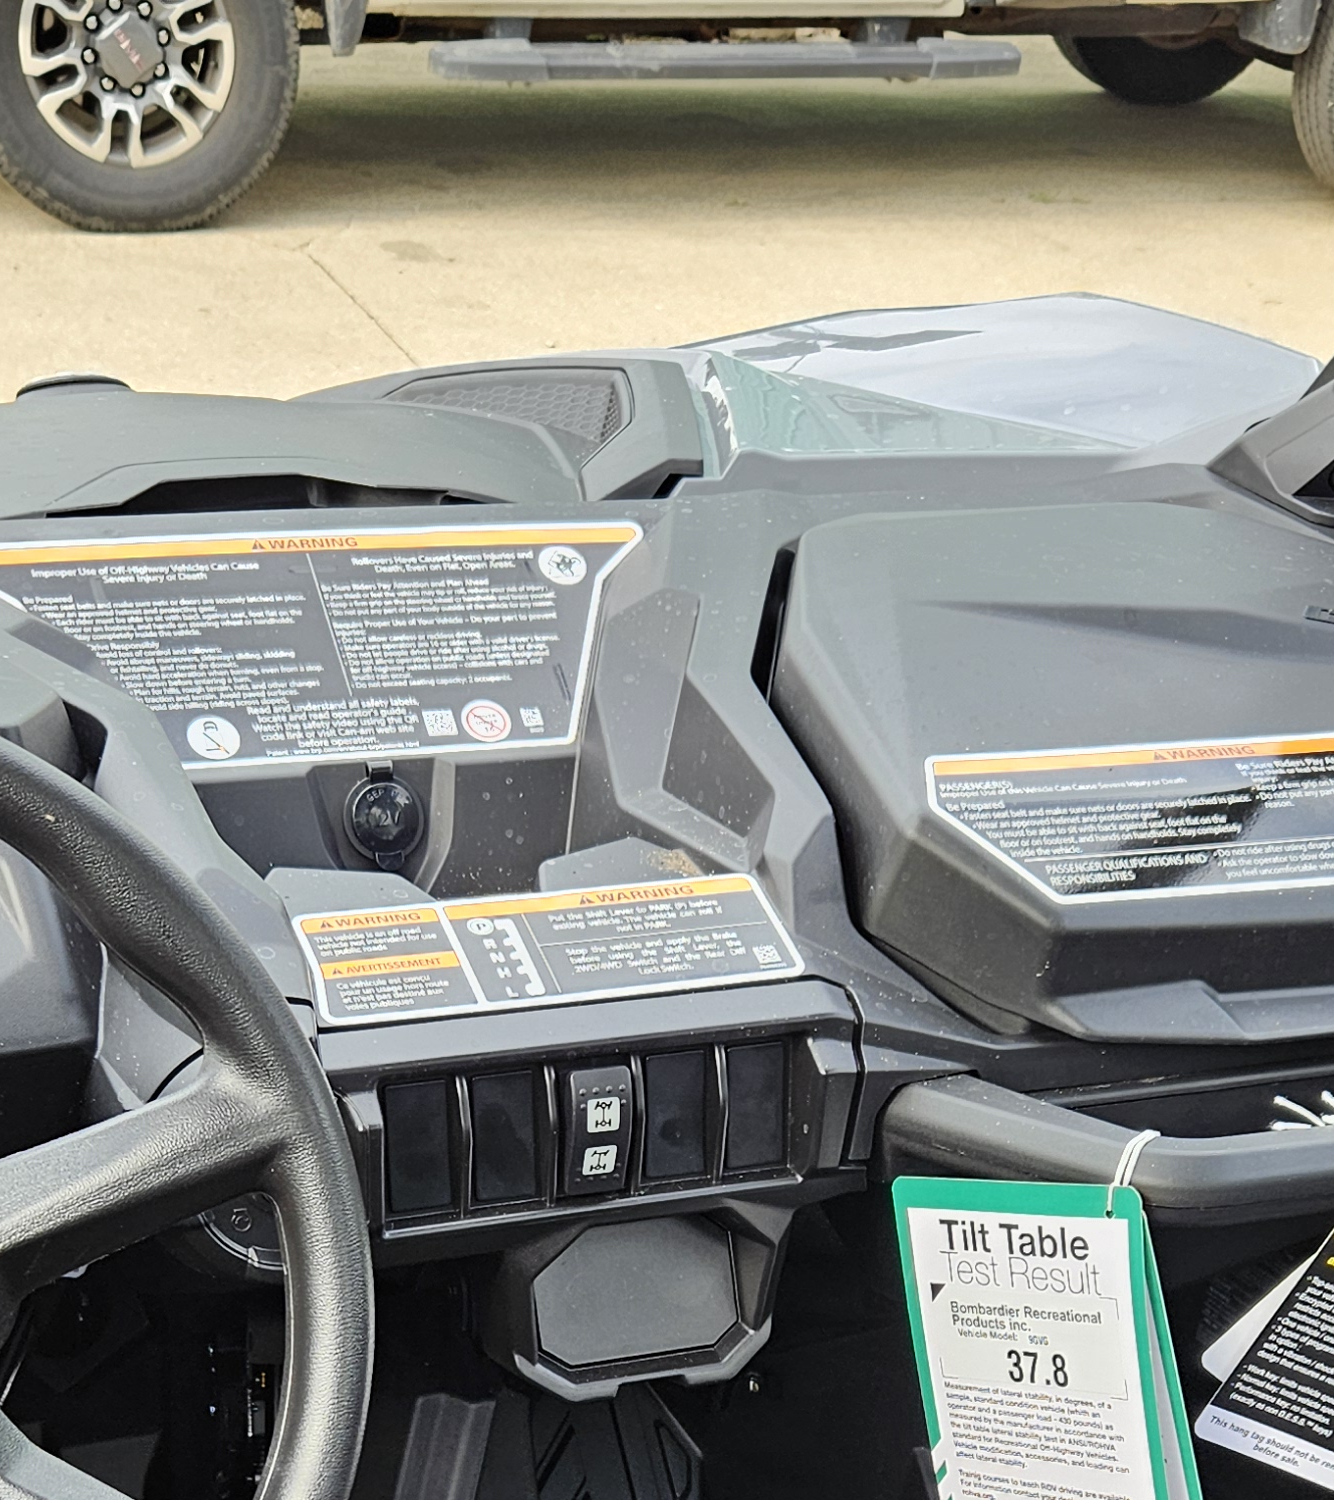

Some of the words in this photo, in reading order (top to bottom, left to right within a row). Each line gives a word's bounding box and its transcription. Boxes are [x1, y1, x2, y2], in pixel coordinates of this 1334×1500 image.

[268, 536, 357, 549] WARNING
[351, 556, 393, 565] Rollovers
[393, 555, 417, 564] Have
[418, 554, 451, 563] Caused
[452, 553, 482, 562] Severe
[483, 551, 515, 561] Injuries
[516, 551, 533, 559] and
[30, 567, 77, 578] Improper
[77, 567, 97, 576] Use
[96, 566, 109, 576] of
[108, 564, 171, 575] Off-Highway
[170, 562, 210, 573] Vehicles
[209, 562, 230, 571] Can
[229, 560, 259, 571] Cause
[102, 575, 136, 584] Severe
[135, 574, 165, 583] Injury
[165, 573, 177, 581] or
[177, 572, 208, 581] Death
[1166, 745, 1255, 759] WARNING
[939, 780, 1012, 792] PASSENGER(S)
[945, 803, 959, 812] Be
[960, 800, 1005, 811] Prepared
[1216, 848, 1230, 856] Do
[1230, 847, 1246, 855] not
[1246, 846, 1263, 854] ride
[1263, 844, 1282, 853] after
[1283, 842, 1306, 851] using
[1306, 840, 1330, 850] drugs
[1044, 861, 1104, 875] PASSENGER
[1101, 855, 1183, 871] QUALIFICATIONS
[1183, 853, 1208, 865] AND
[1221, 859, 1237, 867] Ask
[1237, 857, 1253, 865] the
[1253, 854, 1288, 864] operator
[1288, 853, 1298, 861] to
[1298, 852, 1317, 860] slow
[1048, 870, 1136, 886] RESPONSIBILITIES
[1225, 870, 1242, 879] you
[1242, 868, 1258, 877] feel
[1258, 864, 1318, 876] uncomfortable
[595, 884, 694, 903] WARNING
[334, 912, 421, 927] WARNING
[474, 922, 488, 931] P
[345, 957, 442, 973] AVERTISSEMENT
[489, 952, 505, 963] N
[495, 966, 512, 978] H
[505, 985, 519, 998] L
[938, 1218, 991, 1252] Tilt
[998, 1222, 1090, 1261] Table
[939, 1250, 1000, 1286] Test
[1008, 1256, 1102, 1296] Result
[950, 1300, 1020, 1317] Bombardier
[1023, 1305, 1101, 1324] Recreational
[952, 1313, 1005, 1329] Products
[1009, 1318, 1031, 1332] inc.
[957, 1327, 986, 1339] Vehicle
[990, 1330, 1018, 1342] Model:
[1006, 1348, 1068, 1387] 37.8
[1208, 1415, 1228, 1429] This
[1227, 1422, 1250, 1438] hang
[1249, 1431, 1265, 1443] tag
[1264, 1437, 1293, 1454] should
[1293, 1448, 1309, 1460] not
[1309, 1454, 1320, 1464] be
[1252, 1442, 1280, 1459] before
[1280, 1453, 1301, 1467] sale.
